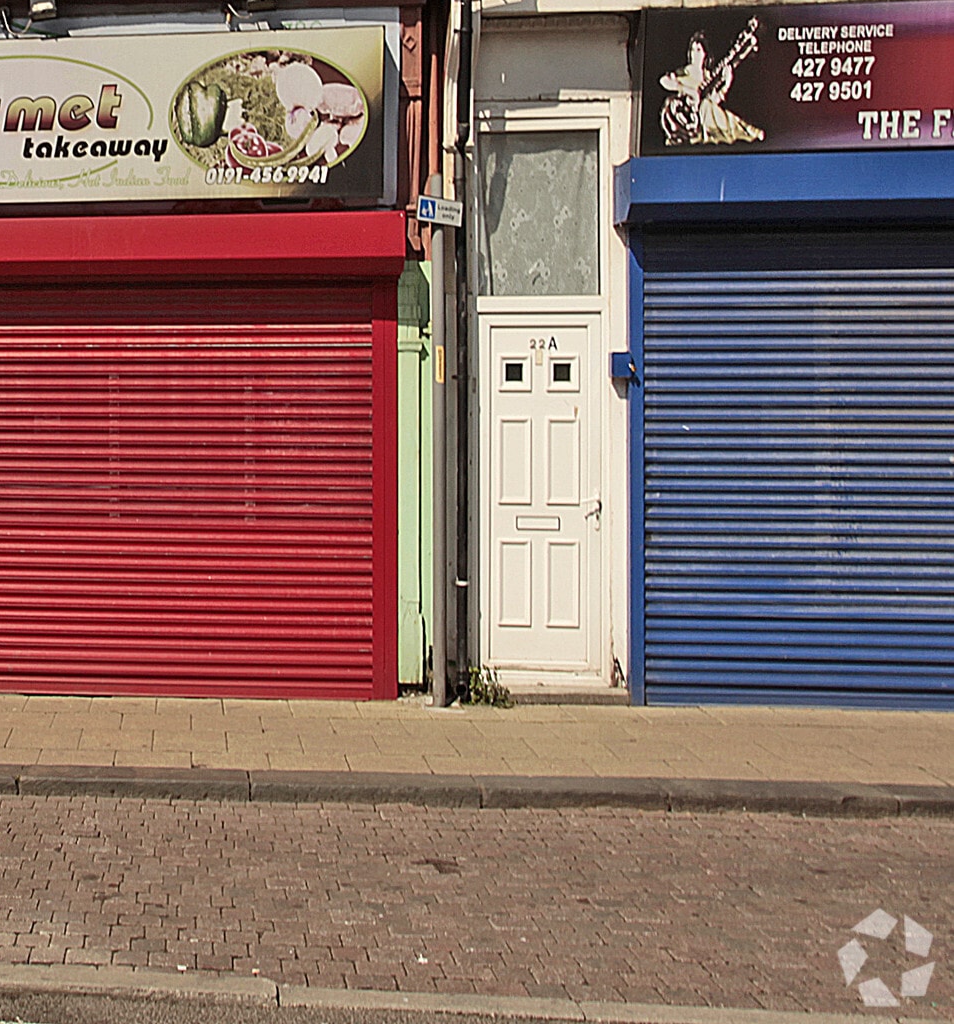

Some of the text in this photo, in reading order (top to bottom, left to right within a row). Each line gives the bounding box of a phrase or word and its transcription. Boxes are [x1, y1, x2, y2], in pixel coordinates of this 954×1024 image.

[778, 24, 894, 41] DELIVERY SERVICE
[798, 40, 872, 55] TELEPHONE
[791, 56, 875, 77] 427 9477
[790, 80, 872, 102] 427 9501
[858, 109, 954, 140] THE F
[22, 135, 168, 162] takeaway
[103, 167, 150, 187] Indian
